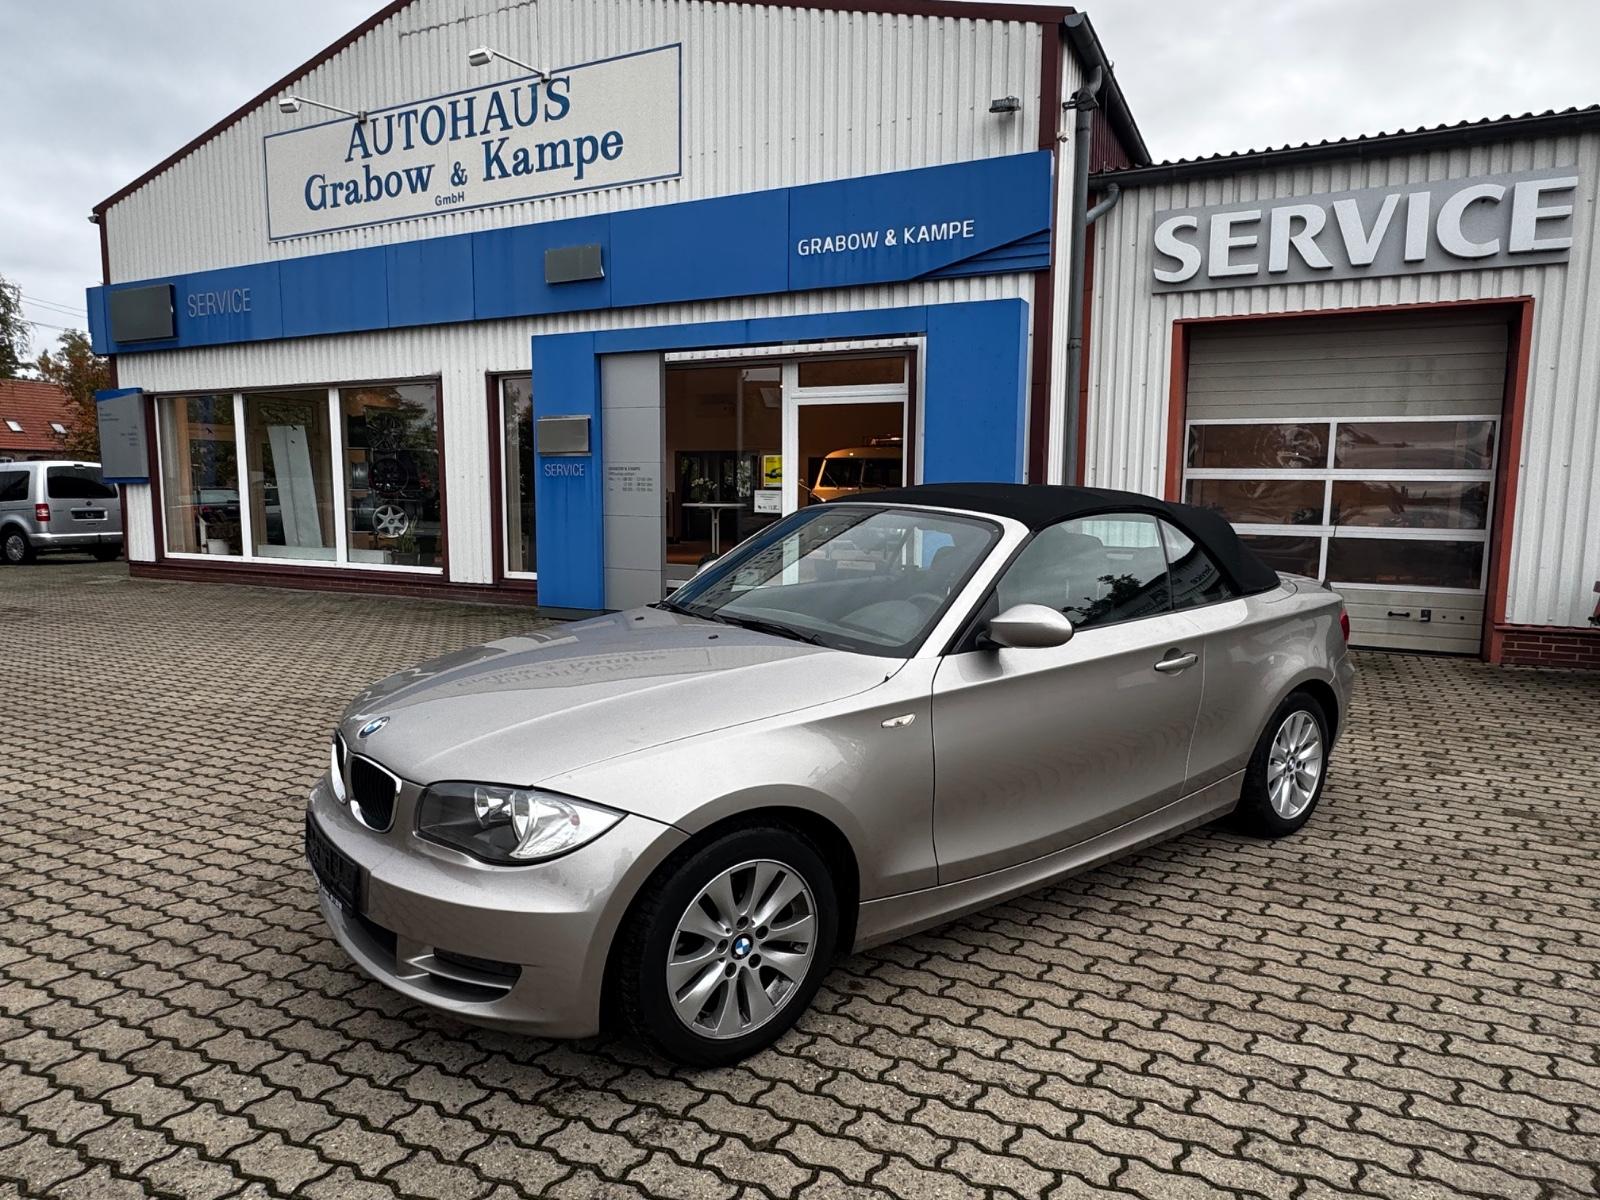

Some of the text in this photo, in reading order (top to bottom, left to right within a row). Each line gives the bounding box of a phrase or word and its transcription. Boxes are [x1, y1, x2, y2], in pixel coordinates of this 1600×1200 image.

[345, 76, 571, 162] AUTOHAUS
[304, 131, 624, 211] Grabow & Kampe
[434, 190, 465, 207] GmbH
[798, 219, 975, 256] GRABOW & KAMPE
[1153, 176, 1579, 284] SERVICE
[187, 287, 252, 318] SERVICE
[544, 463, 585, 477] SERVICE
